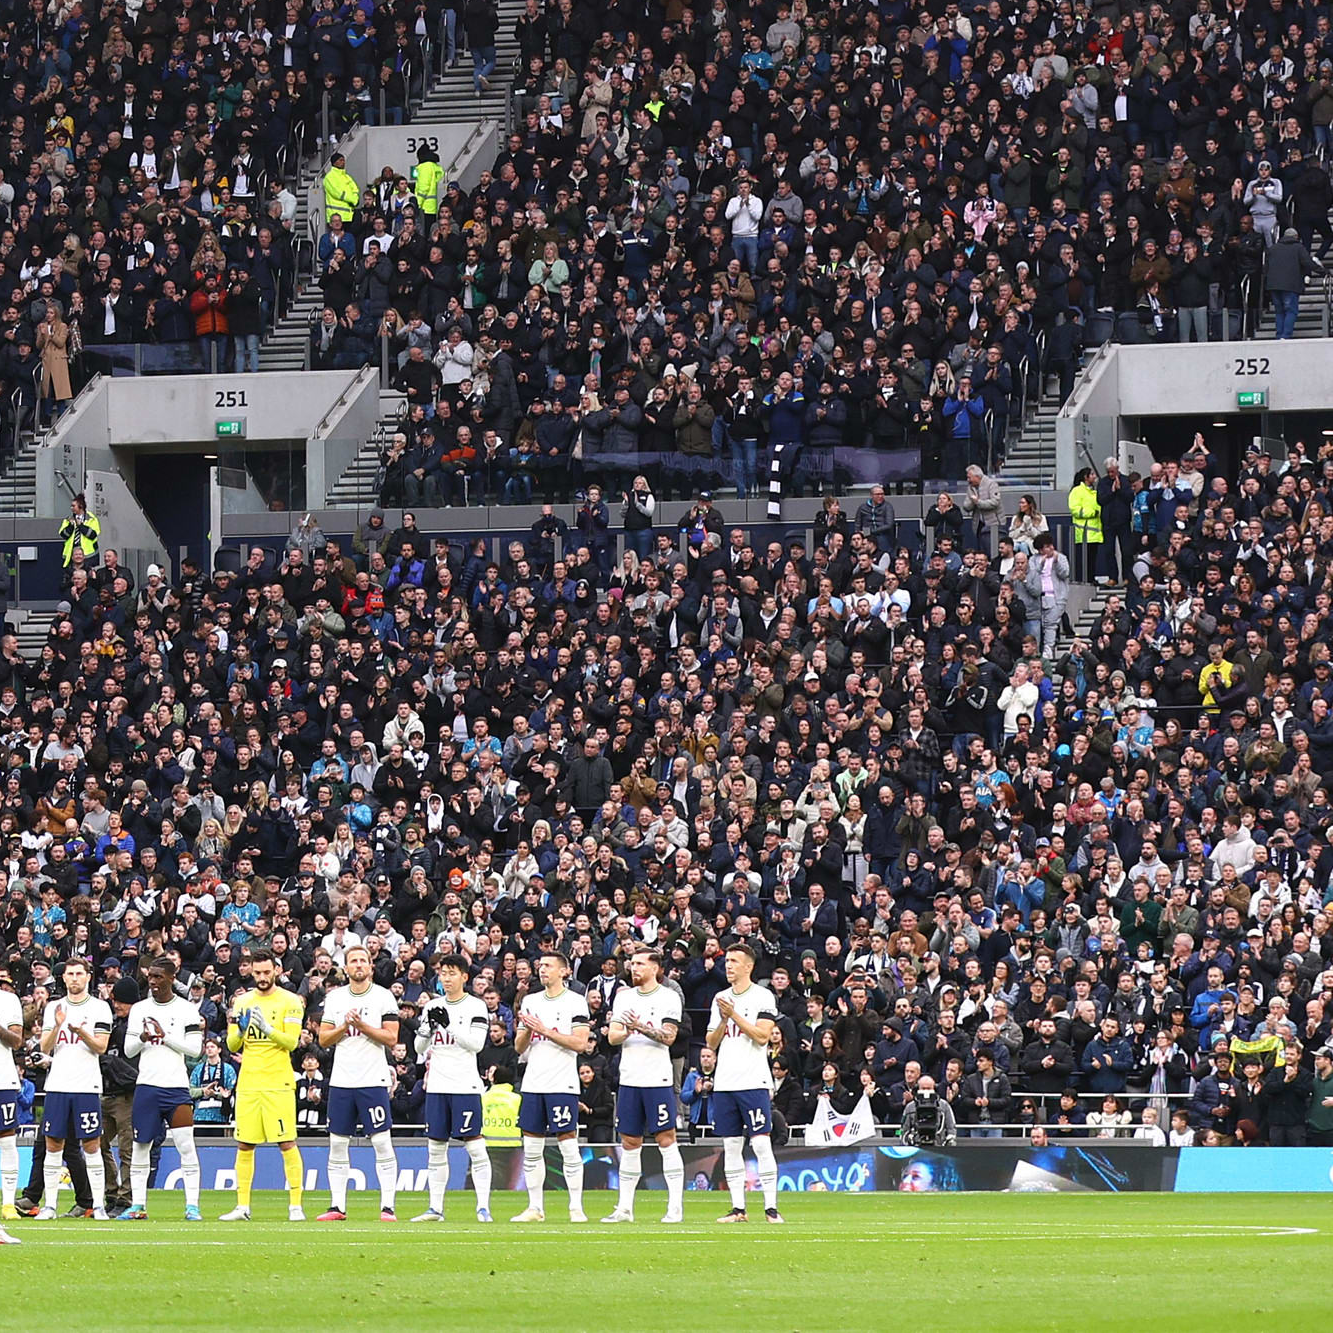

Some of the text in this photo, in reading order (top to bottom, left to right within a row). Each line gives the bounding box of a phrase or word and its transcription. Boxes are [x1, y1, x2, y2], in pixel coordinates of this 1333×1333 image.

[1235, 358, 1270, 375] 252
[215, 391, 248, 407] 251
[975, 786, 992, 796] AIA
[1, 1103, 16, 1120] 17
[368, 1106, 386, 1123] 10
[462, 1111, 473, 1129] 7
[552, 1106, 572, 1123] 34
[658, 1104, 669, 1122] 5
[748, 1109, 765, 1126] 14
[80, 1112, 99, 1129] 33
[278, 1119, 284, 1132] 1
